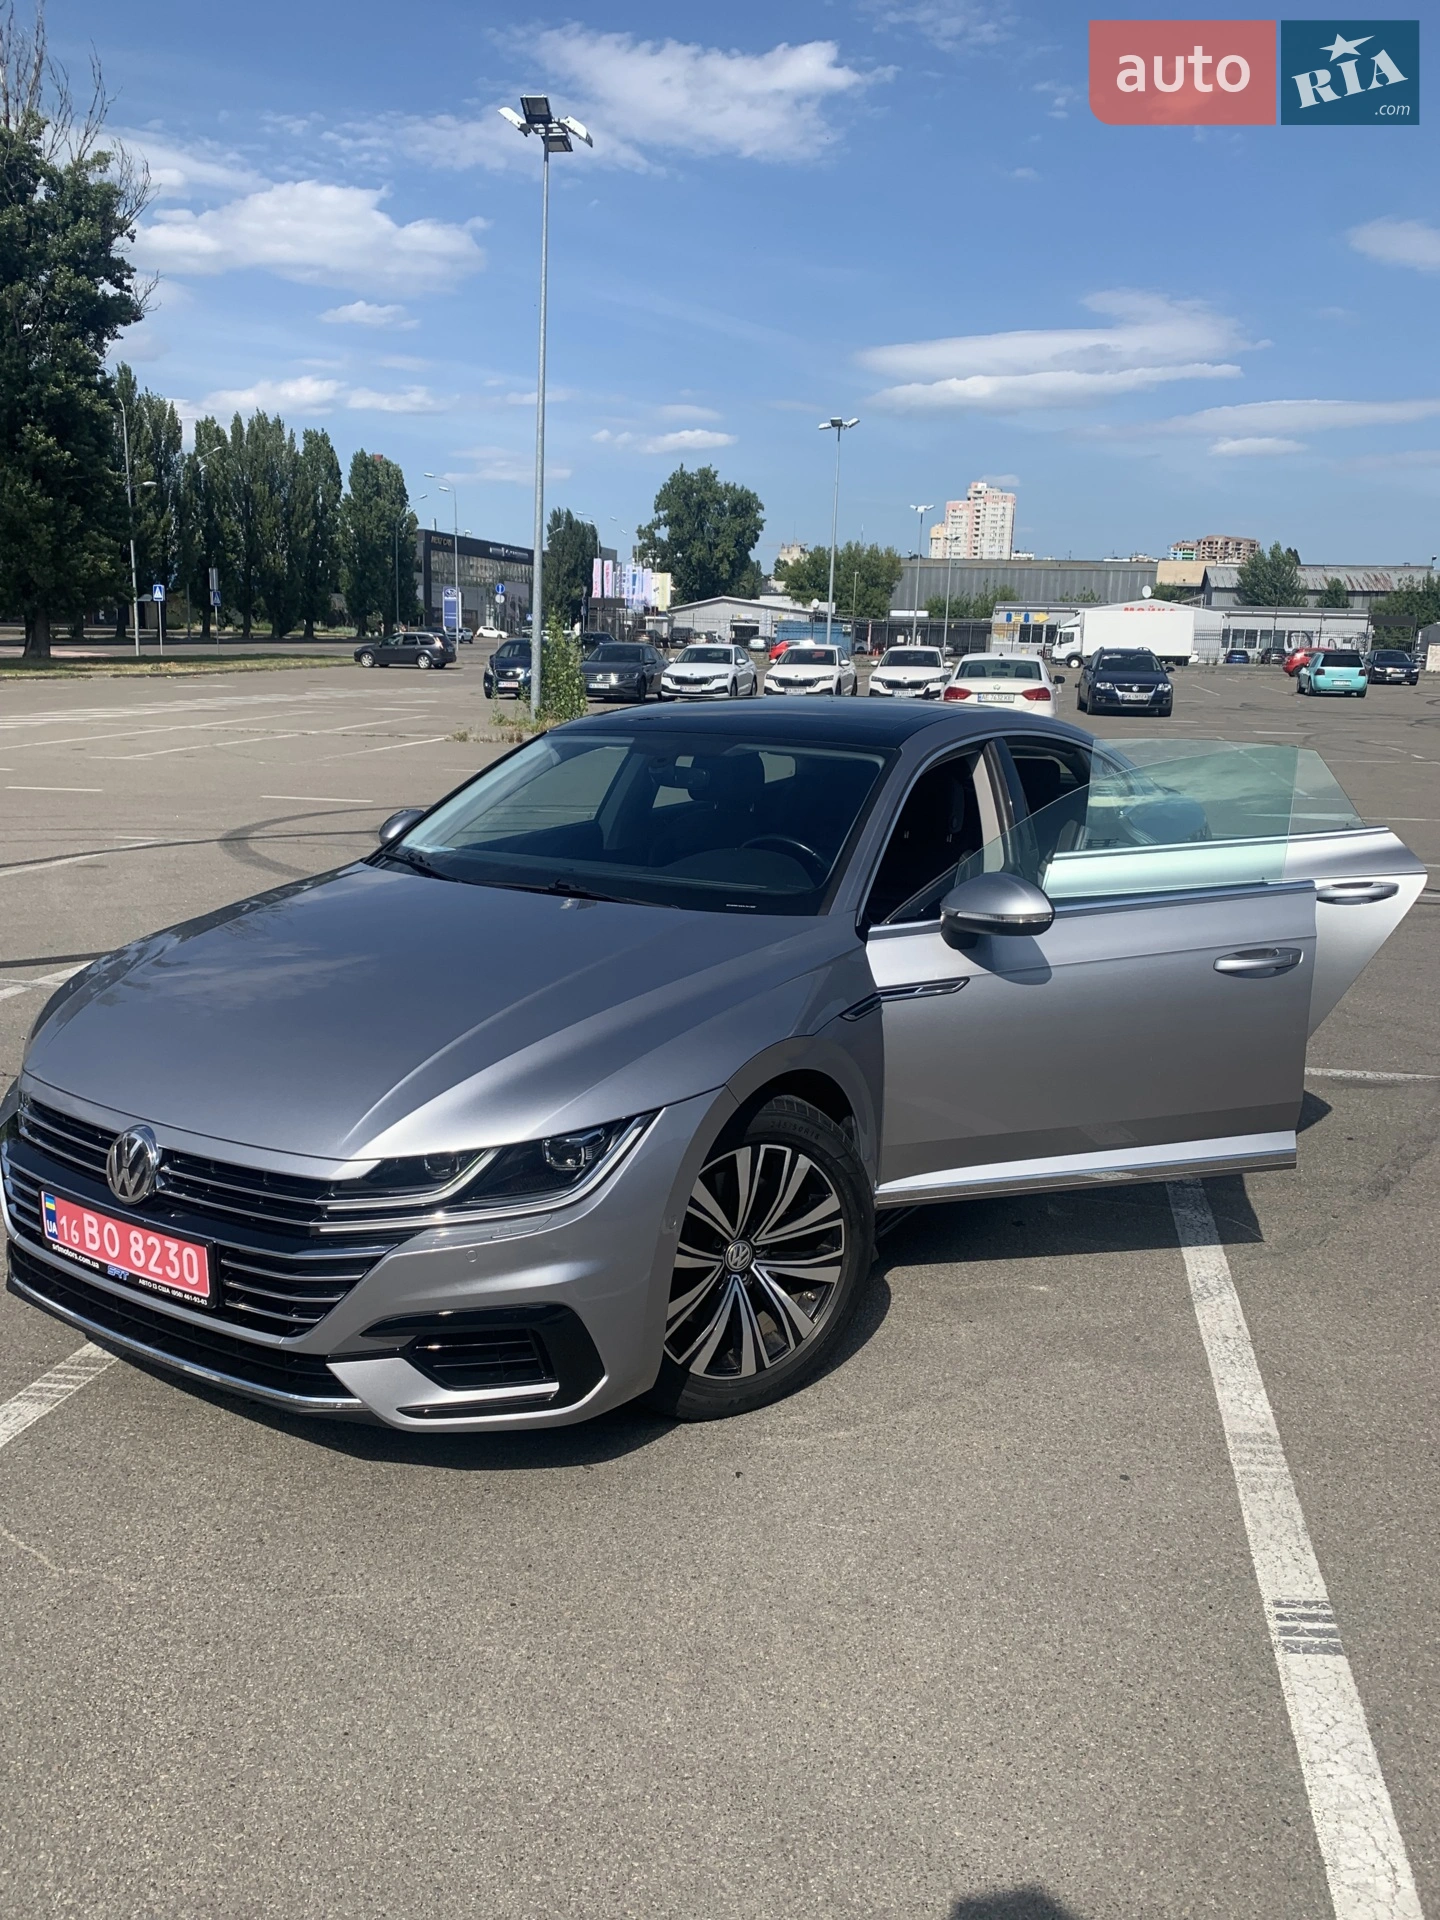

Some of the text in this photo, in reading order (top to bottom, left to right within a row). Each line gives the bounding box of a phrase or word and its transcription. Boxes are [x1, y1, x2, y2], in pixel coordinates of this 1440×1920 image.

[47, 1220, 58, 1234] UA
[60, 1212, 199, 1285] 16 BO 8230
